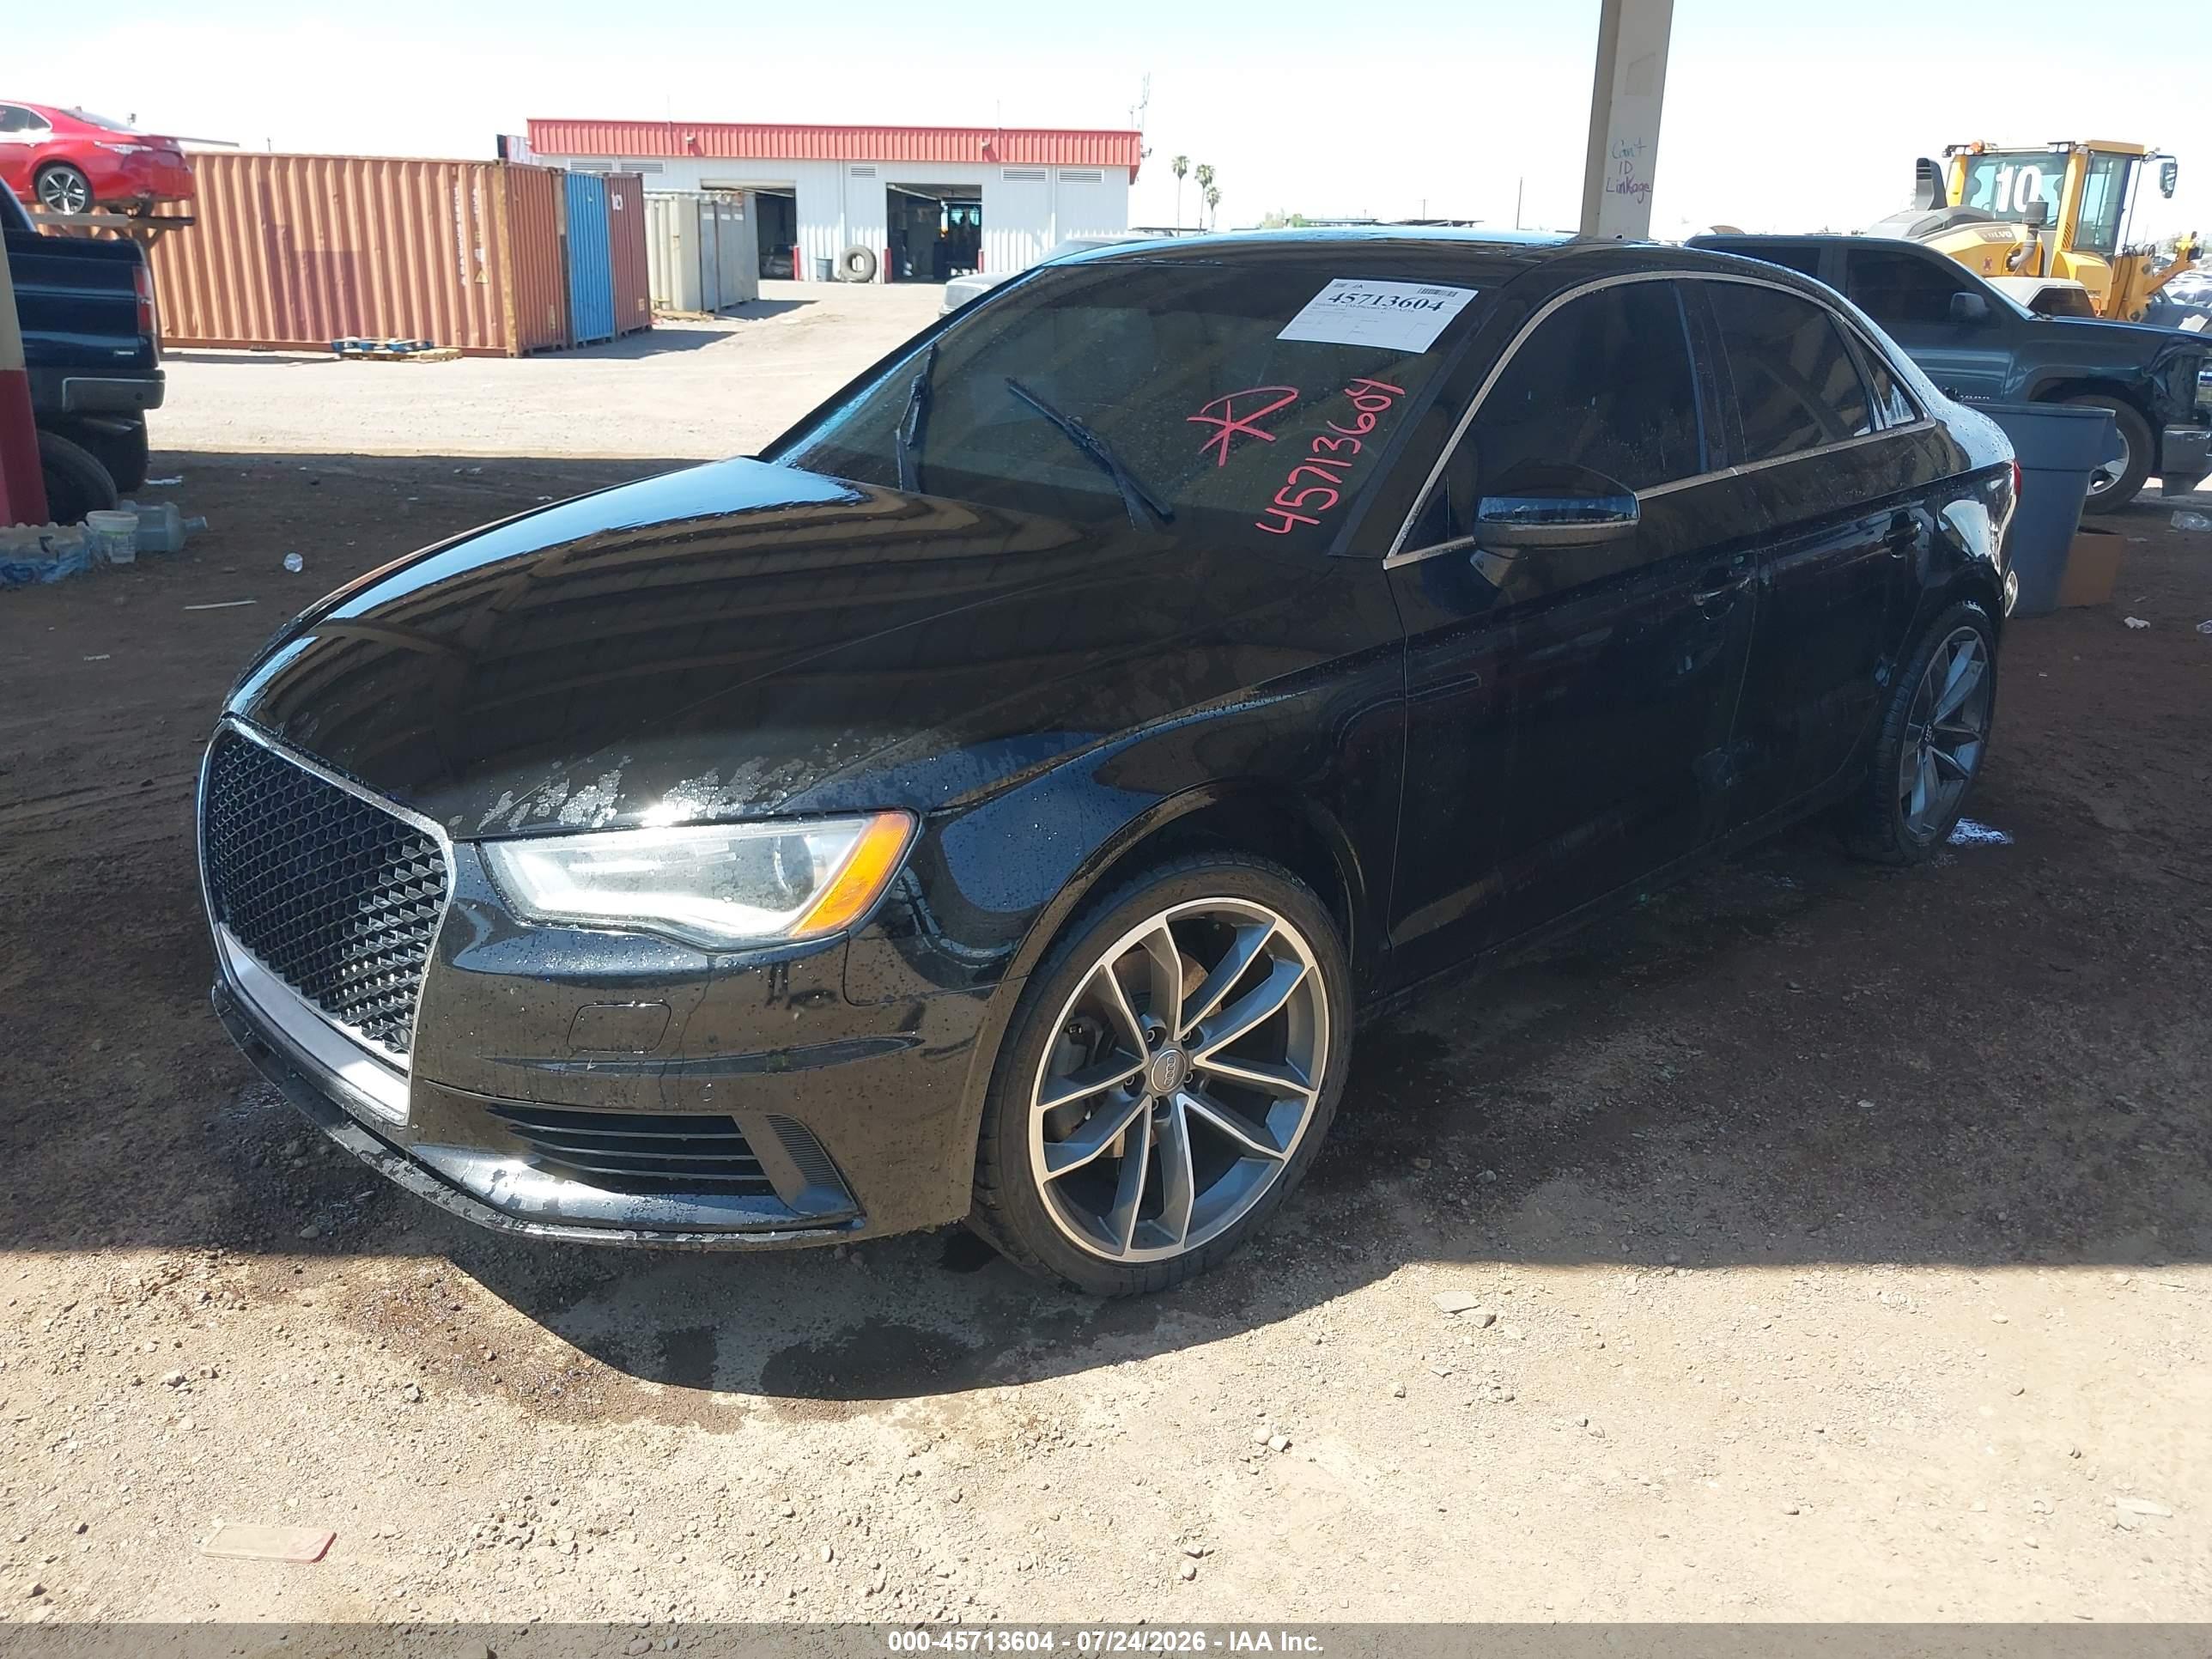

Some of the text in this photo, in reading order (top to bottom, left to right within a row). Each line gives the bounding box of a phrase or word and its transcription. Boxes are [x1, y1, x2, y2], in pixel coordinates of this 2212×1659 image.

[1618, 160, 1633, 175] ID
[1996, 164, 2043, 213] 10
[1328, 291, 1446, 313] 45713604
[1255, 378, 1407, 534] 45713604
